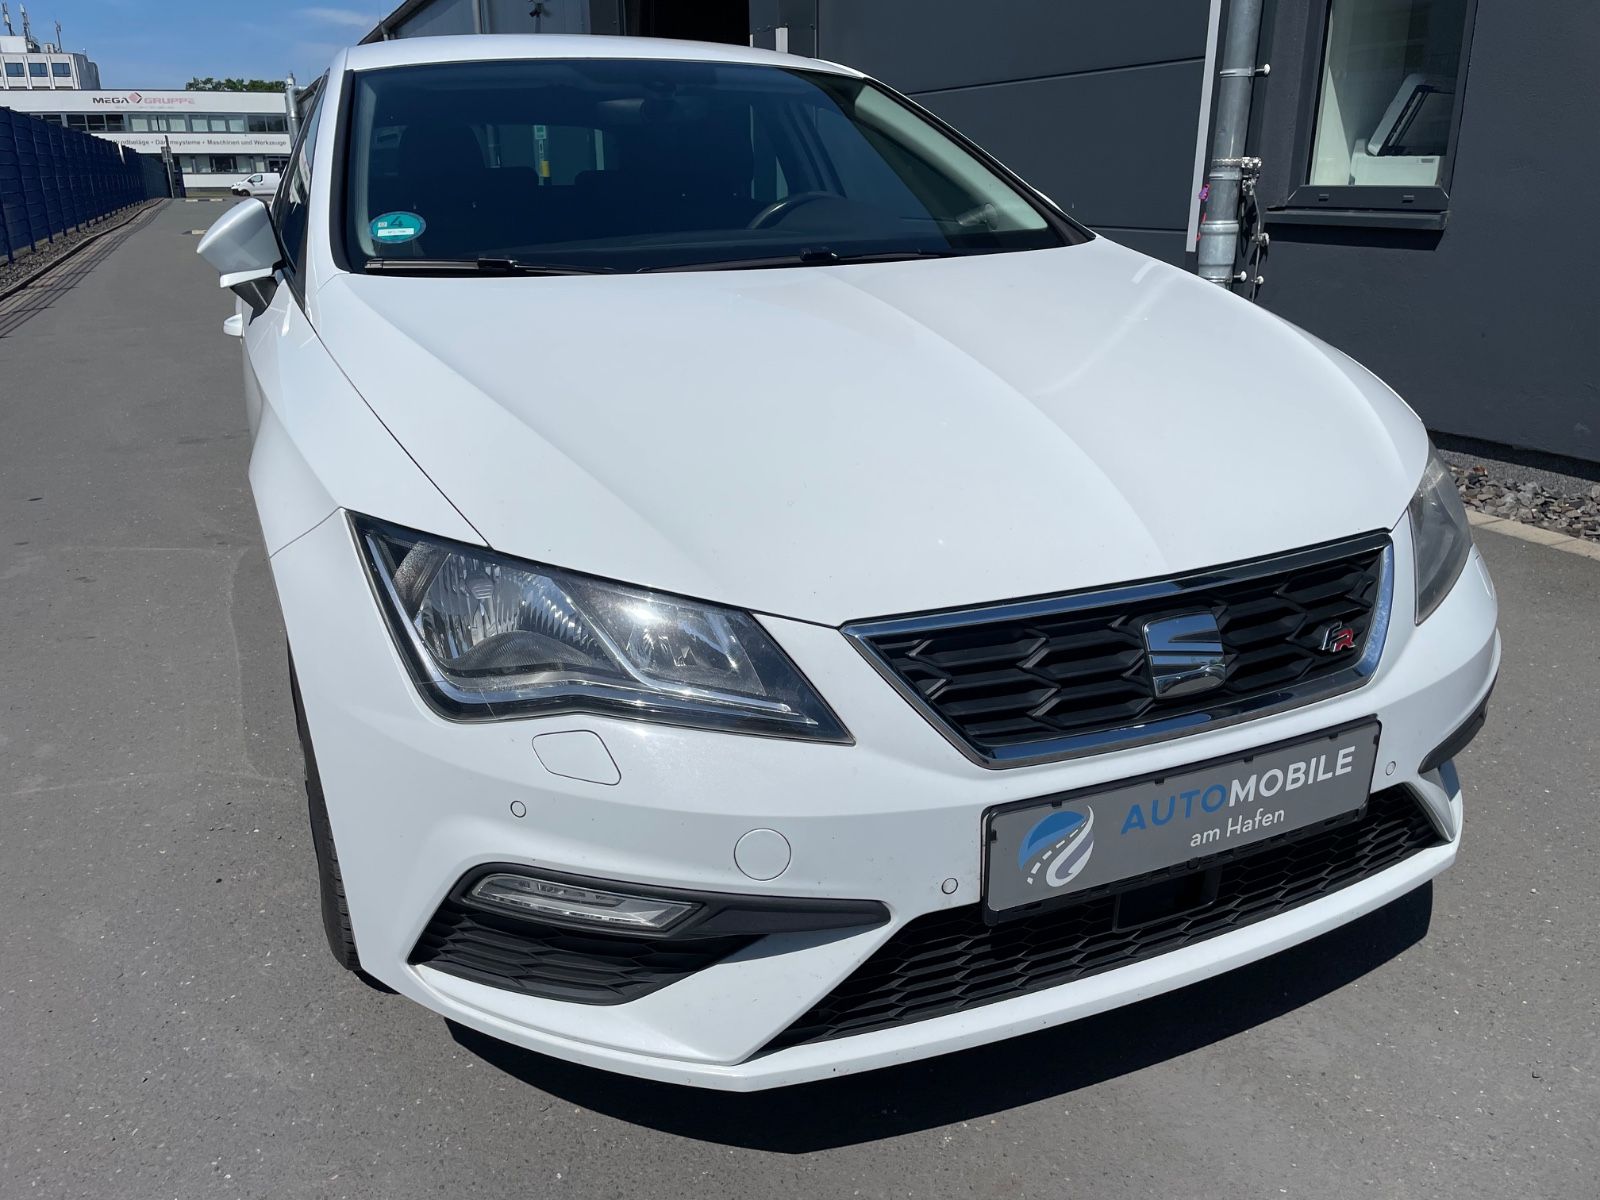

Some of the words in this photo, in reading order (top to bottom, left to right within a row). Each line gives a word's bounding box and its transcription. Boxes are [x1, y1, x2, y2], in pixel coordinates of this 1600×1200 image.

[390, 216, 404, 228] 4
[1121, 745, 1356, 836] AUTOMOBILE
[1190, 827, 1221, 848] am
[1226, 807, 1285, 838] Hafen
